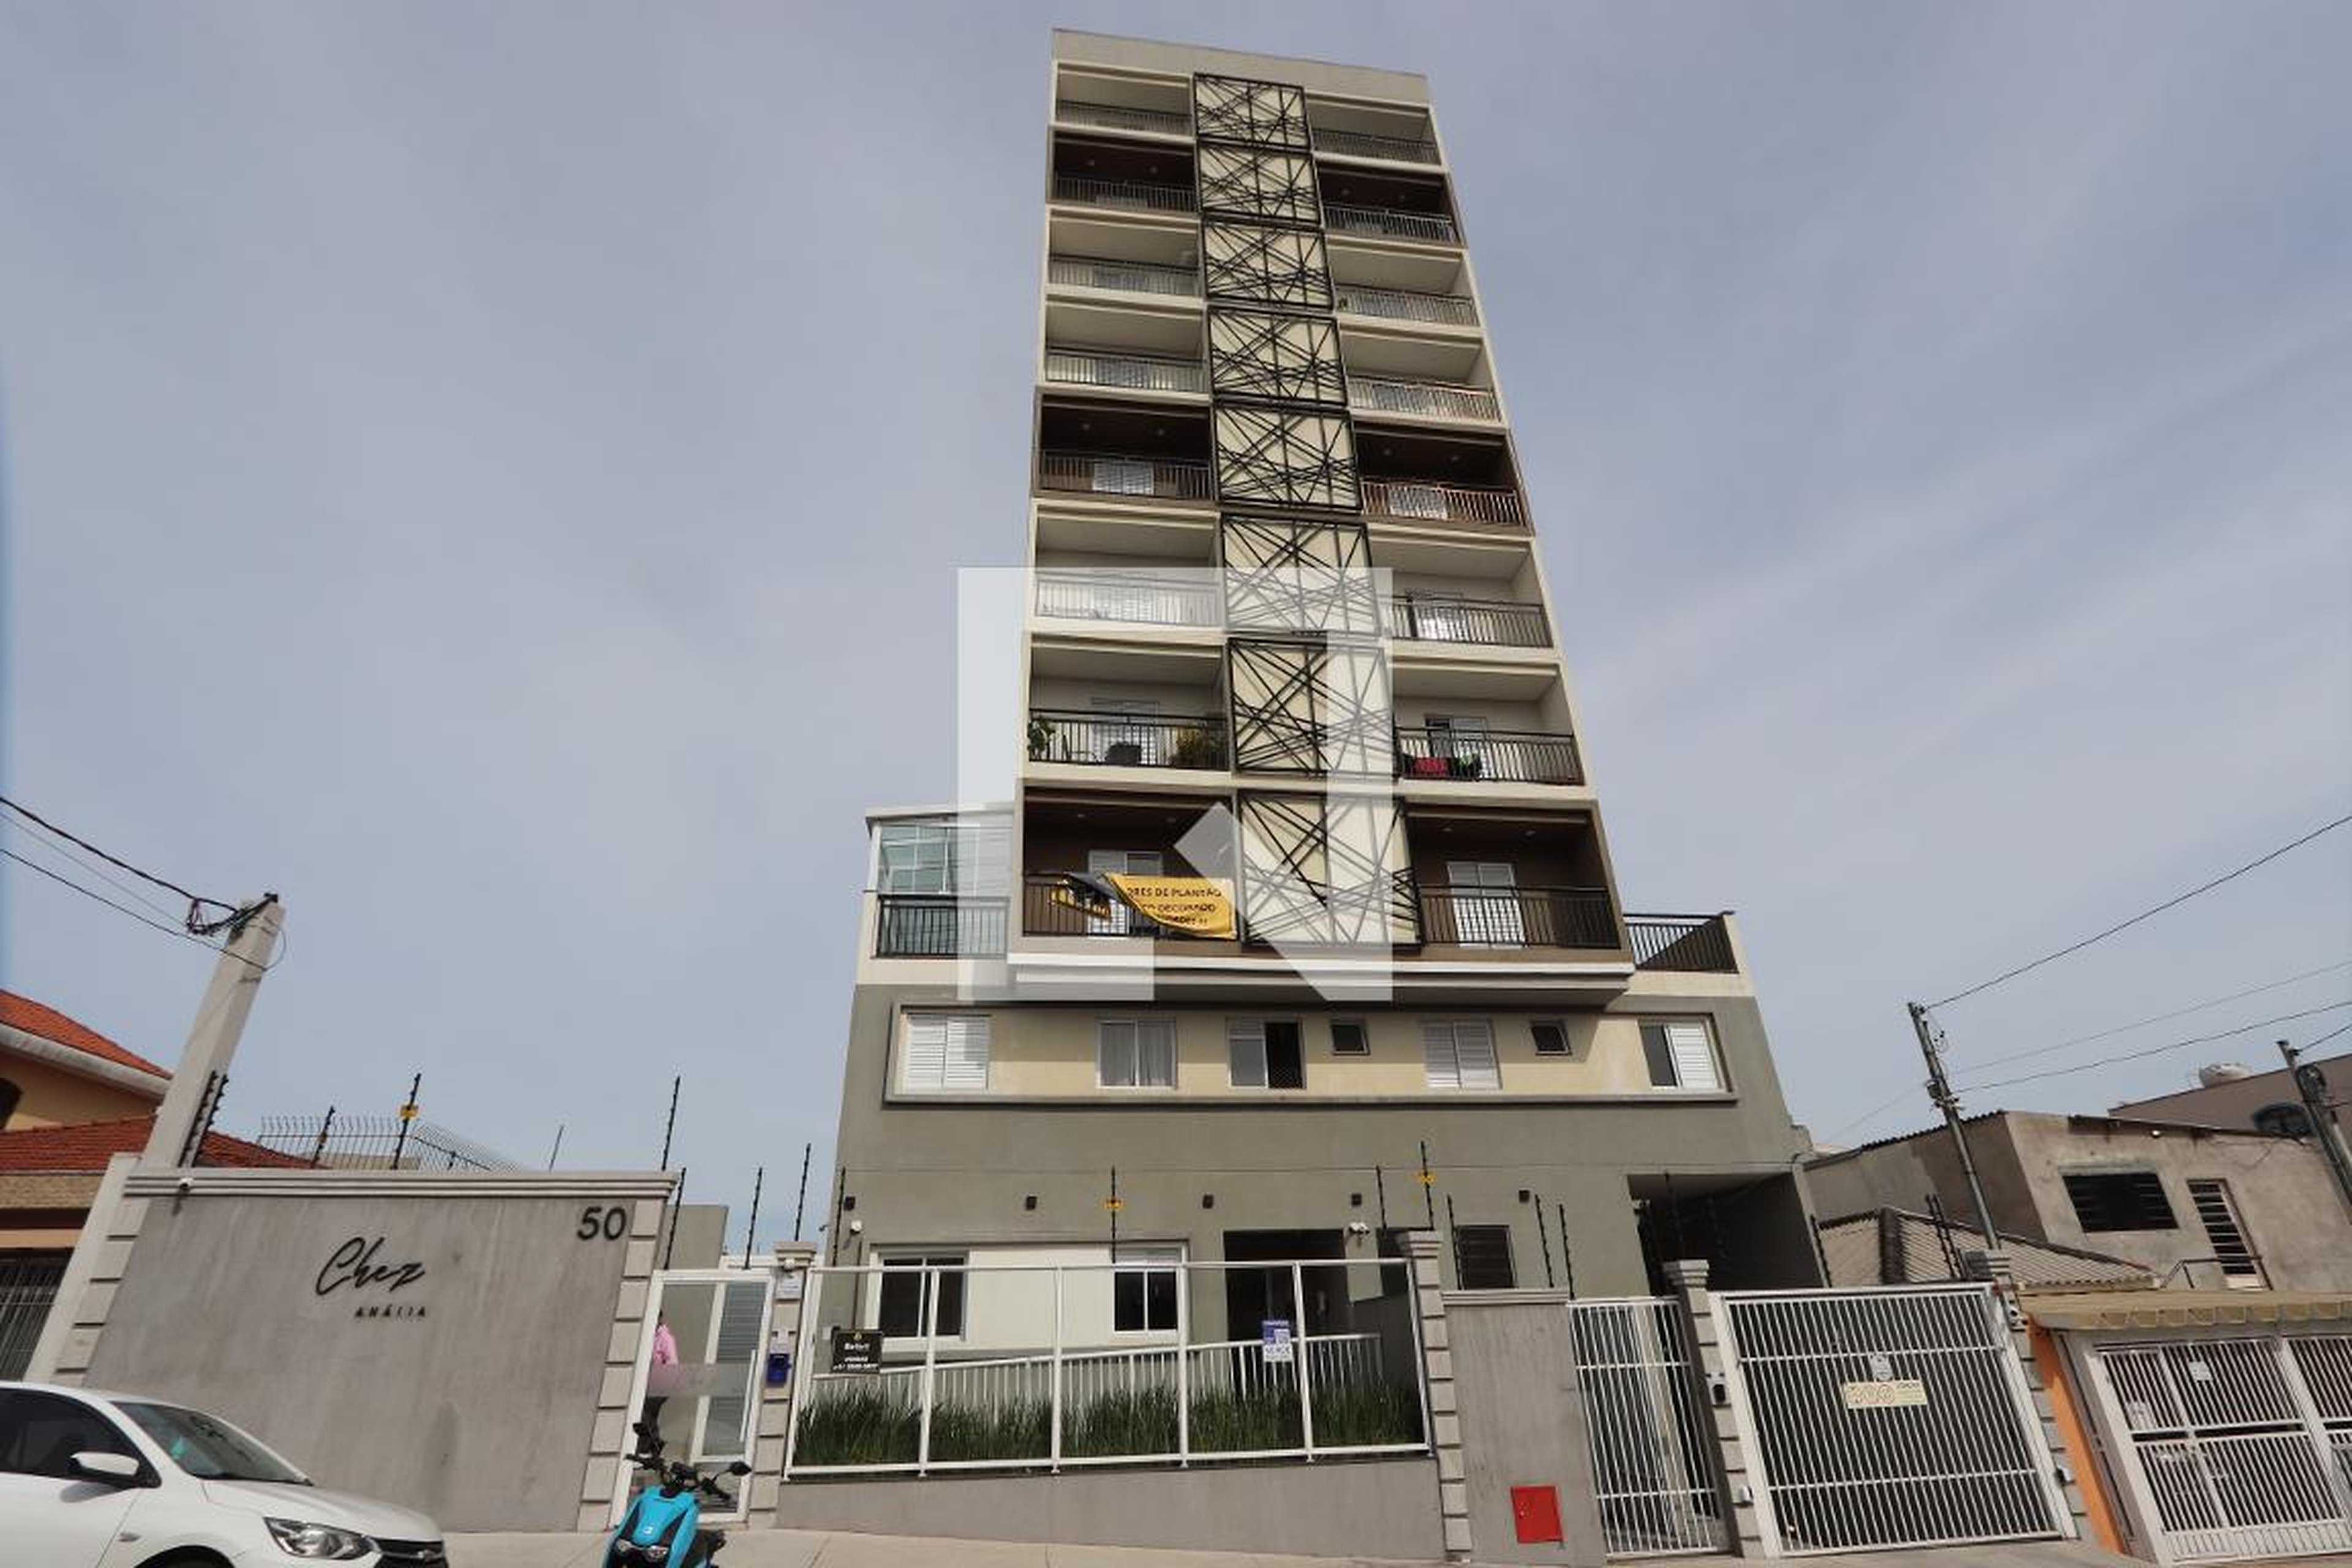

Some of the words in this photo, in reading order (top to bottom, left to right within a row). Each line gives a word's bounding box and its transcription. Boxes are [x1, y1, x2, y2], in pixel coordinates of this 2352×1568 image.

[1155, 888, 1169, 897] DE
[1172, 886, 1222, 897] PLANTÃO
[577, 1206, 627, 1241] 50
[316, 1237, 425, 1295] Chez
